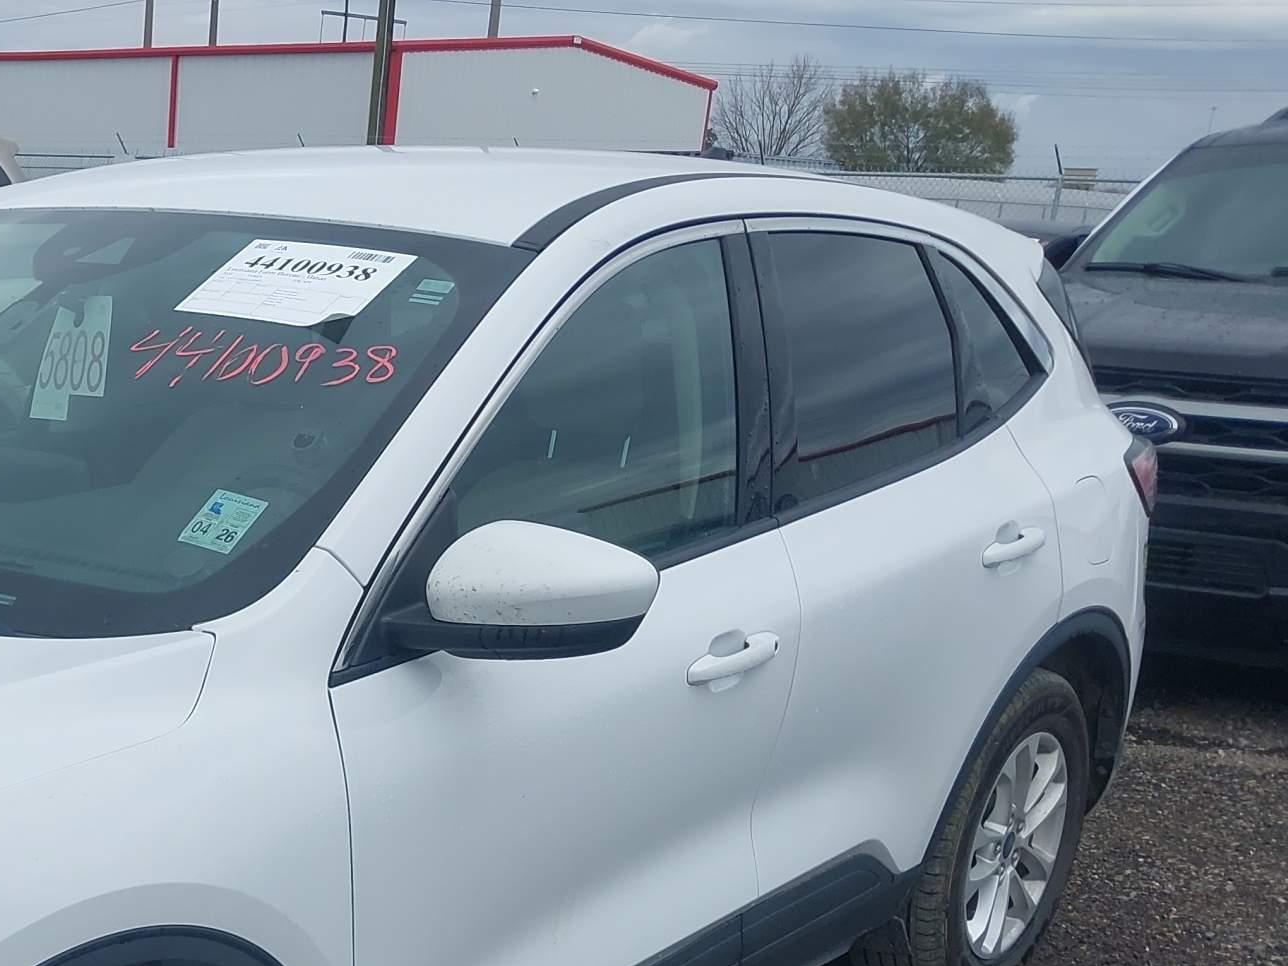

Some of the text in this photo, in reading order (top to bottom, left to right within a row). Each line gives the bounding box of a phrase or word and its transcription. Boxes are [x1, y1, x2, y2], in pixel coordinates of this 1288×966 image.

[245, 255, 378, 281] 44100938
[38, 330, 106, 393] 5808
[129, 326, 398, 388] 44100938
[1118, 412, 1158, 433] Ford
[191, 520, 238, 543] 04 26
